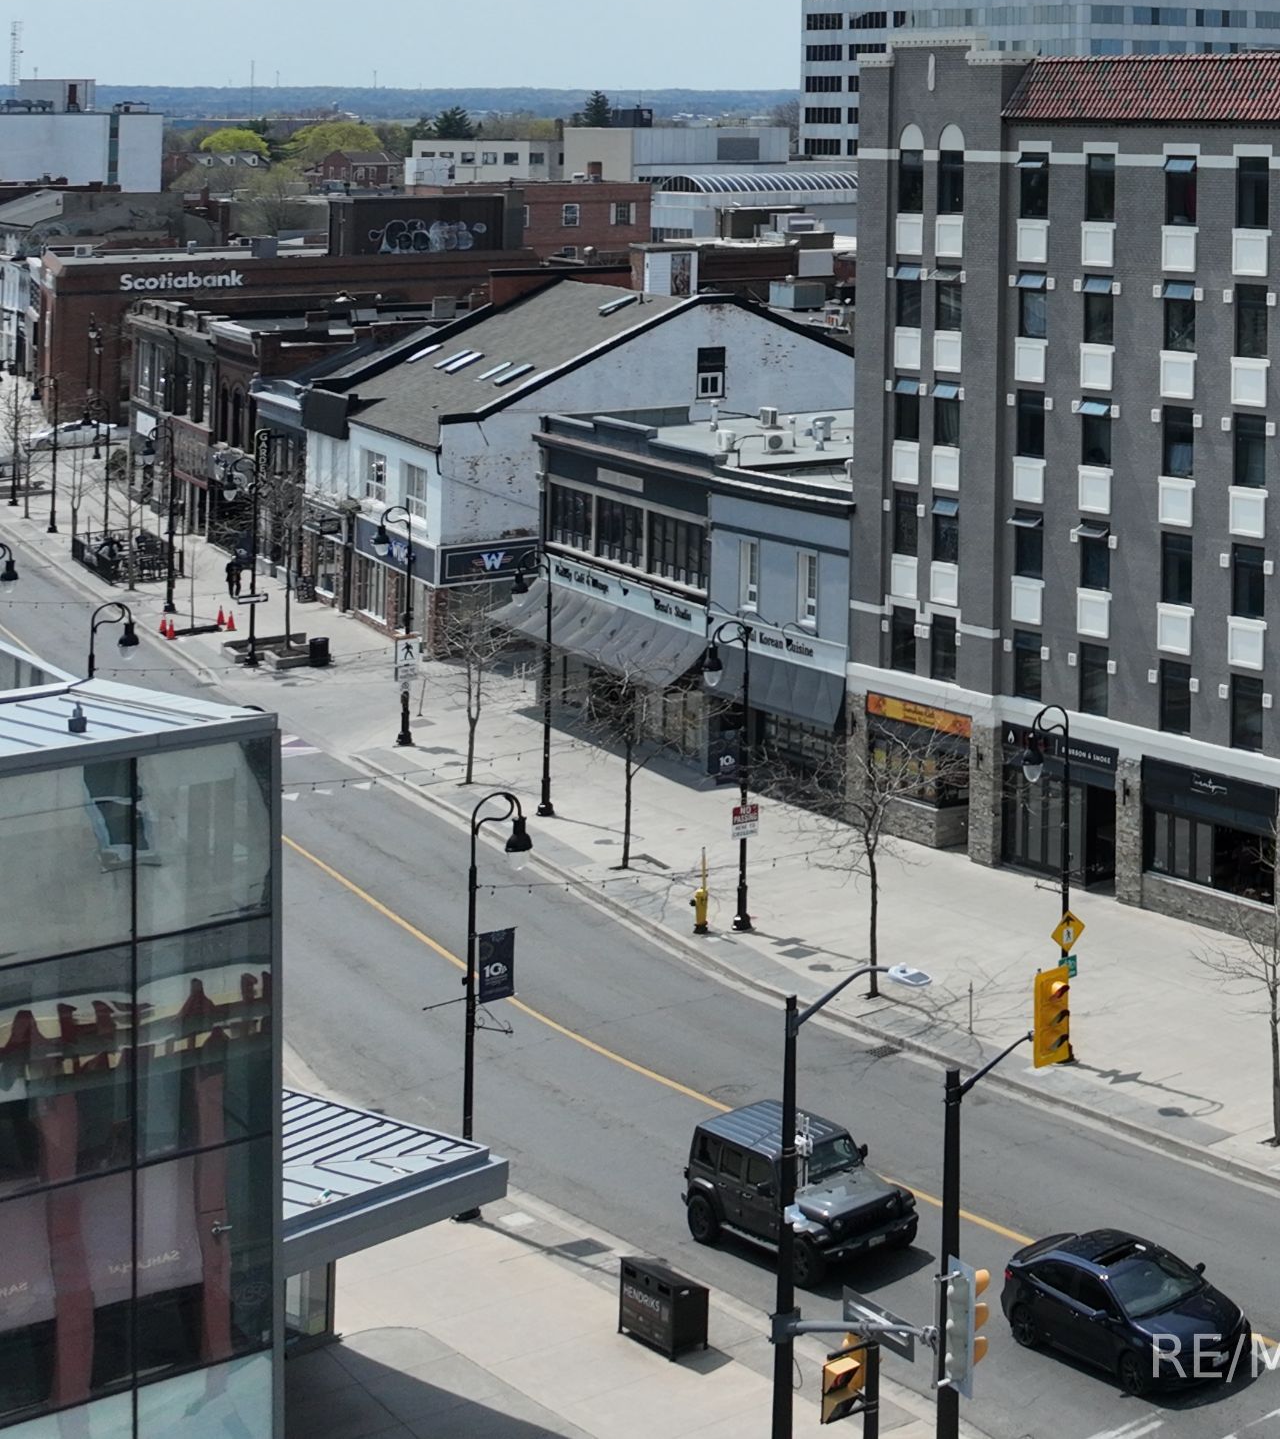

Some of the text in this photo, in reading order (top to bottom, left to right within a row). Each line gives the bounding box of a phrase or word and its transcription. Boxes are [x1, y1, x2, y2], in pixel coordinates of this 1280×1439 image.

[120, 270, 243, 290] Scotiabank
[480, 551, 506, 570] W
[759, 631, 784, 650] Korean
[787, 639, 814, 658] Cuisine
[1061, 746, 1087, 758] BURBON
[1093, 752, 1111, 764] SMOKE
[740, 805, 752, 815] NO
[623, 1283, 660, 1313] HENDRIKS
